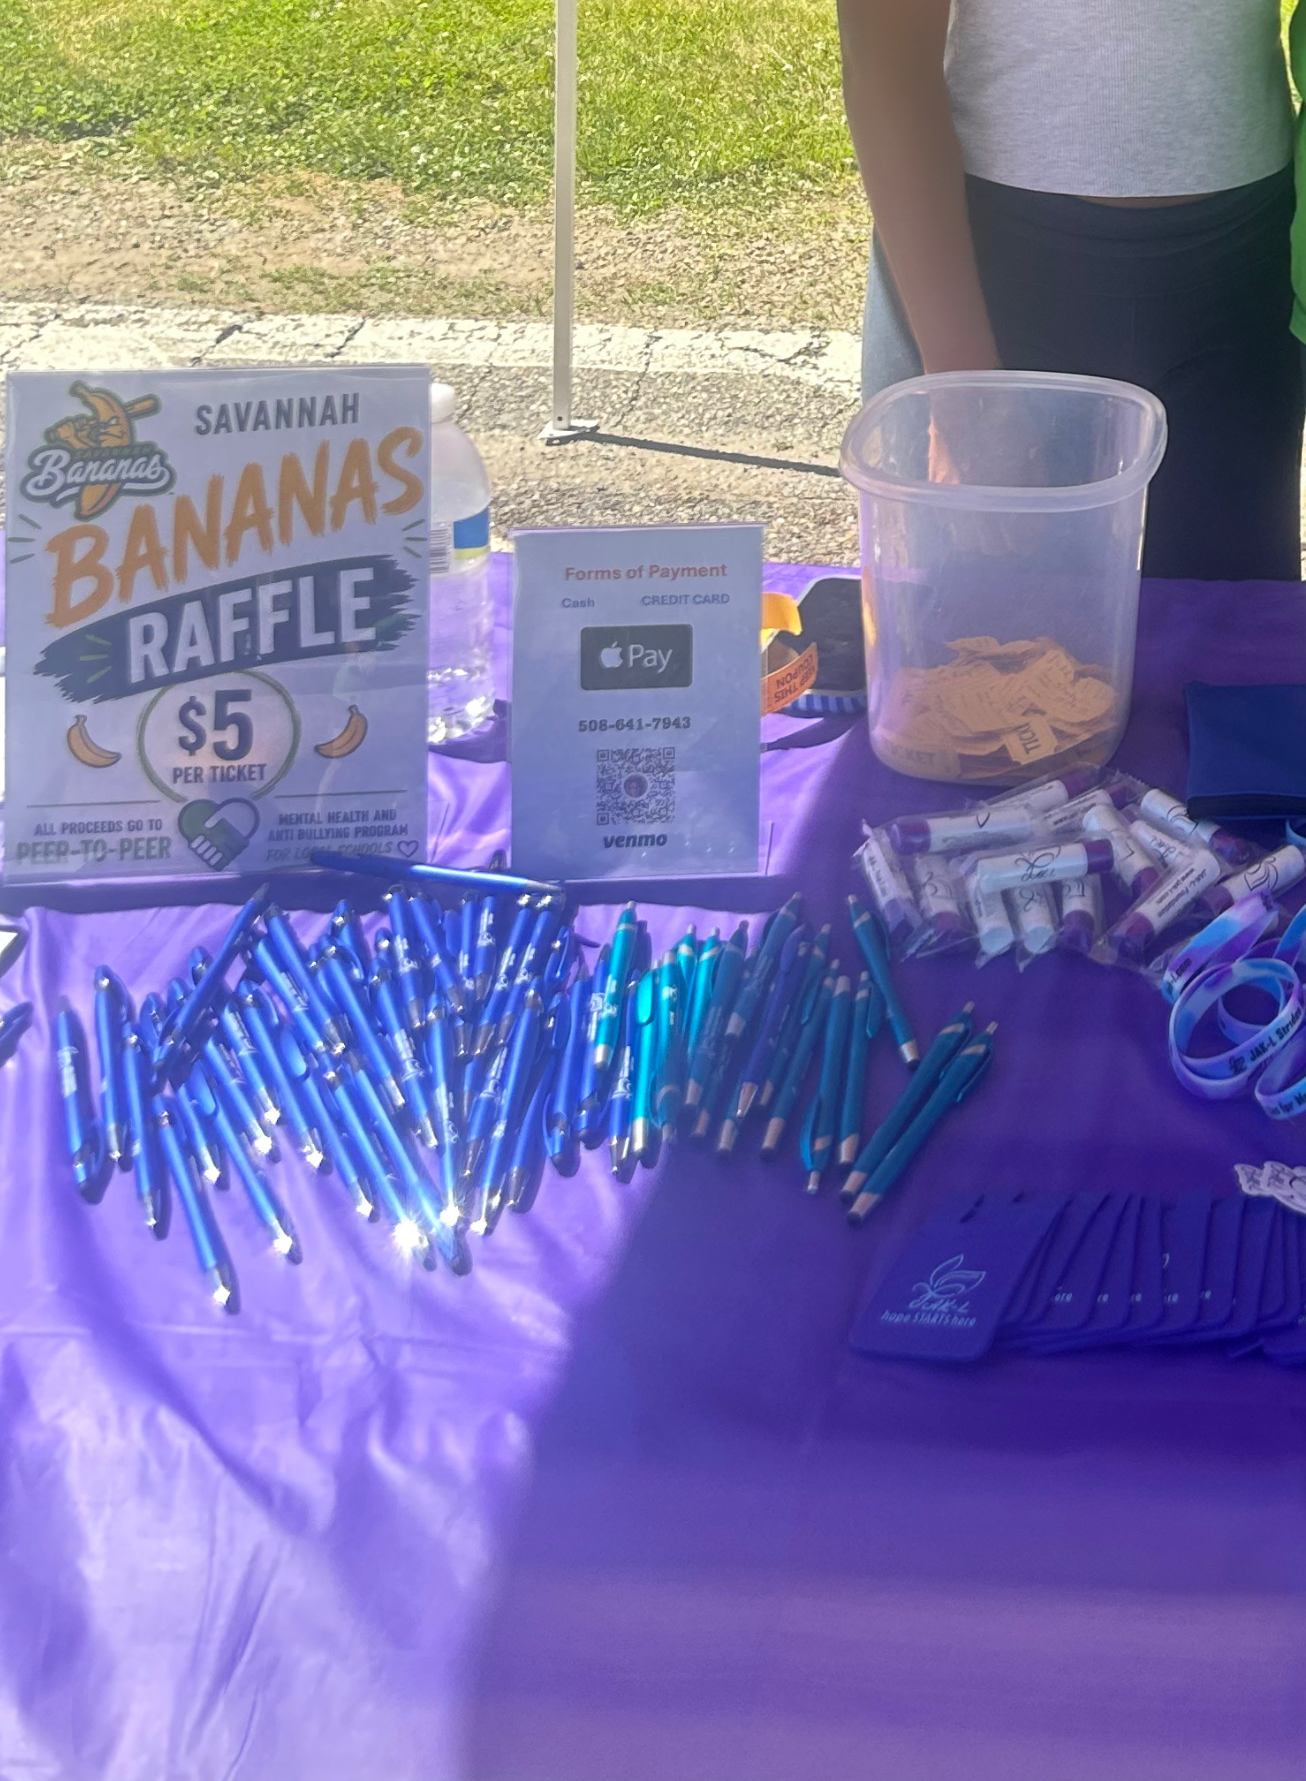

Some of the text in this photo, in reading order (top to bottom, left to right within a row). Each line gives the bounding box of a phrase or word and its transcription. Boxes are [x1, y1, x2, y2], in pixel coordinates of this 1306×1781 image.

[195, 392, 360, 436] SAVANNAH
[25, 448, 170, 502] Bananas
[43, 426, 426, 629] BANANAS
[565, 563, 728, 581] Forms of Payment
[561, 593, 730, 609] Cash CREDIT CARD
[127, 566, 378, 685] RAFFLE
[628, 644, 673, 673] Pay
[177, 688, 254, 762] $5
[578, 717, 692, 733] 508-641-7943
[172, 763, 267, 785] PER TICKET
[278, 808, 397, 826] MENTAL HEALTH AND
[33, 819, 163, 836] ALL PROCEEDS GO TO
[268, 824, 408, 842] ANTI BULLYING PROGRAM
[15, 836, 173, 865] PEER-TO-PEER
[602, 832, 668, 849] venmo
[266, 848, 291, 861] FOR
[1250, 1036, 1279, 1062] JAK-L
[881, 1310, 911, 1325] hope
[913, 1312, 950, 1326] STARTS
